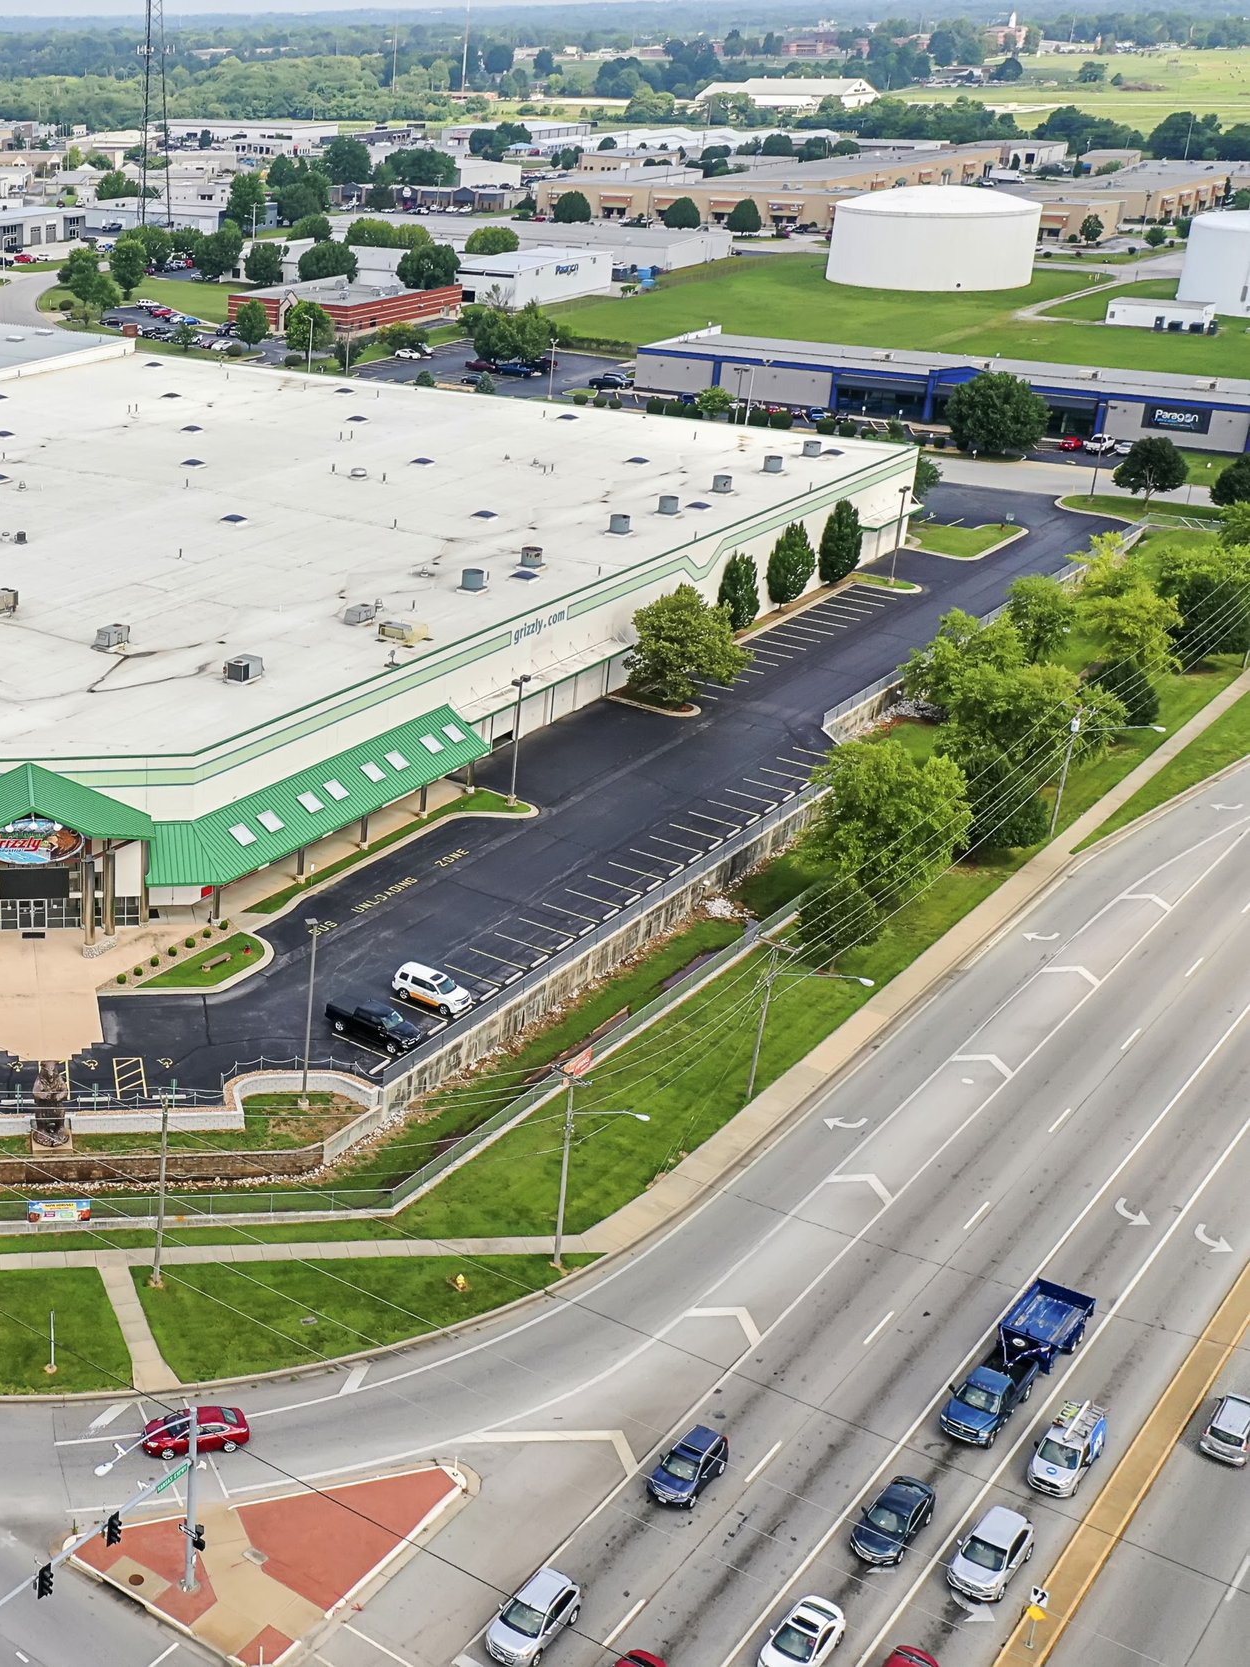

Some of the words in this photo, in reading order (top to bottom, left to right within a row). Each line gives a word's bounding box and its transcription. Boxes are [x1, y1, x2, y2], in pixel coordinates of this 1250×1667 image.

[1154, 409, 1199, 423] Paragon
[513, 609, 566, 645] grizzly.com
[350, 876, 418, 914] UNLOADING
[434, 847, 470, 868] ZONE
